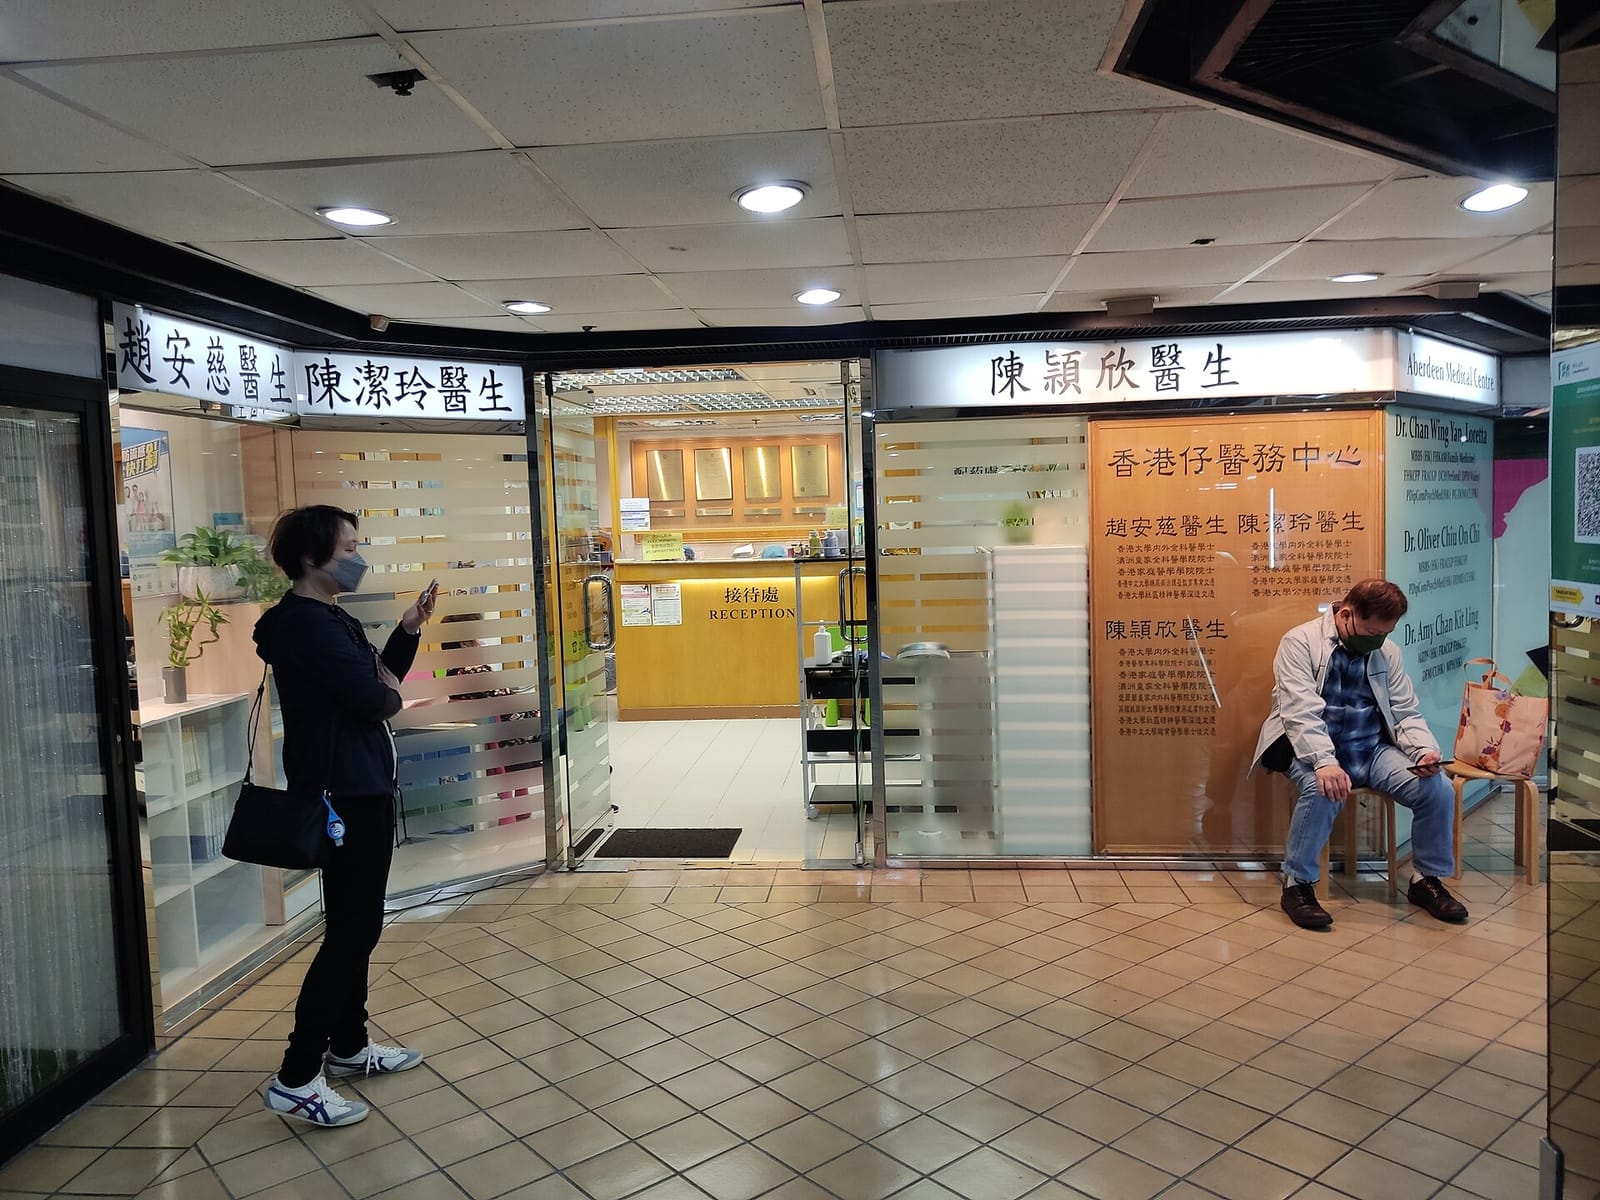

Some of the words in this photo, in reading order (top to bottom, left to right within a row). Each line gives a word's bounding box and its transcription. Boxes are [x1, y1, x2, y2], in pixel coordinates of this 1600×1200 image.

[119, 316, 292, 405] 趙安慈醫生
[1407, 352, 1444, 380] Aberdeen
[1446, 361, 1473, 386] Medical
[1474, 368, 1495, 392] Centre
[305, 357, 512, 414] 陳潔玲醫生
[1395, 414, 1408, 437] Dr.
[1409, 415, 1429, 440] Chan
[1430, 418, 1449, 448] Wing
[1466, 421, 1488, 445] Loretta
[1108, 441, 1362, 478] 香港仔醫務中心
[1105, 514, 1228, 539] 趙安慈醫生
[1237, 510, 1365, 535] 陳潔玲醫生
[1404, 530, 1416, 553] Dr.
[1417, 528, 1440, 551] Oliver
[1441, 525, 1457, 547] Chiu
[1458, 525, 1469, 545] On
[1469, 523, 1480, 544] Chi
[724, 586, 779, 604] 接待處
[709, 608, 796, 620] RECEPTION
[1404, 623, 1417, 646] Dr.
[1417, 620, 1434, 646] Amy
[1435, 613, 1453, 637] Chan
[1454, 608, 1465, 630] Kit
[1465, 606, 1479, 630] Ling
